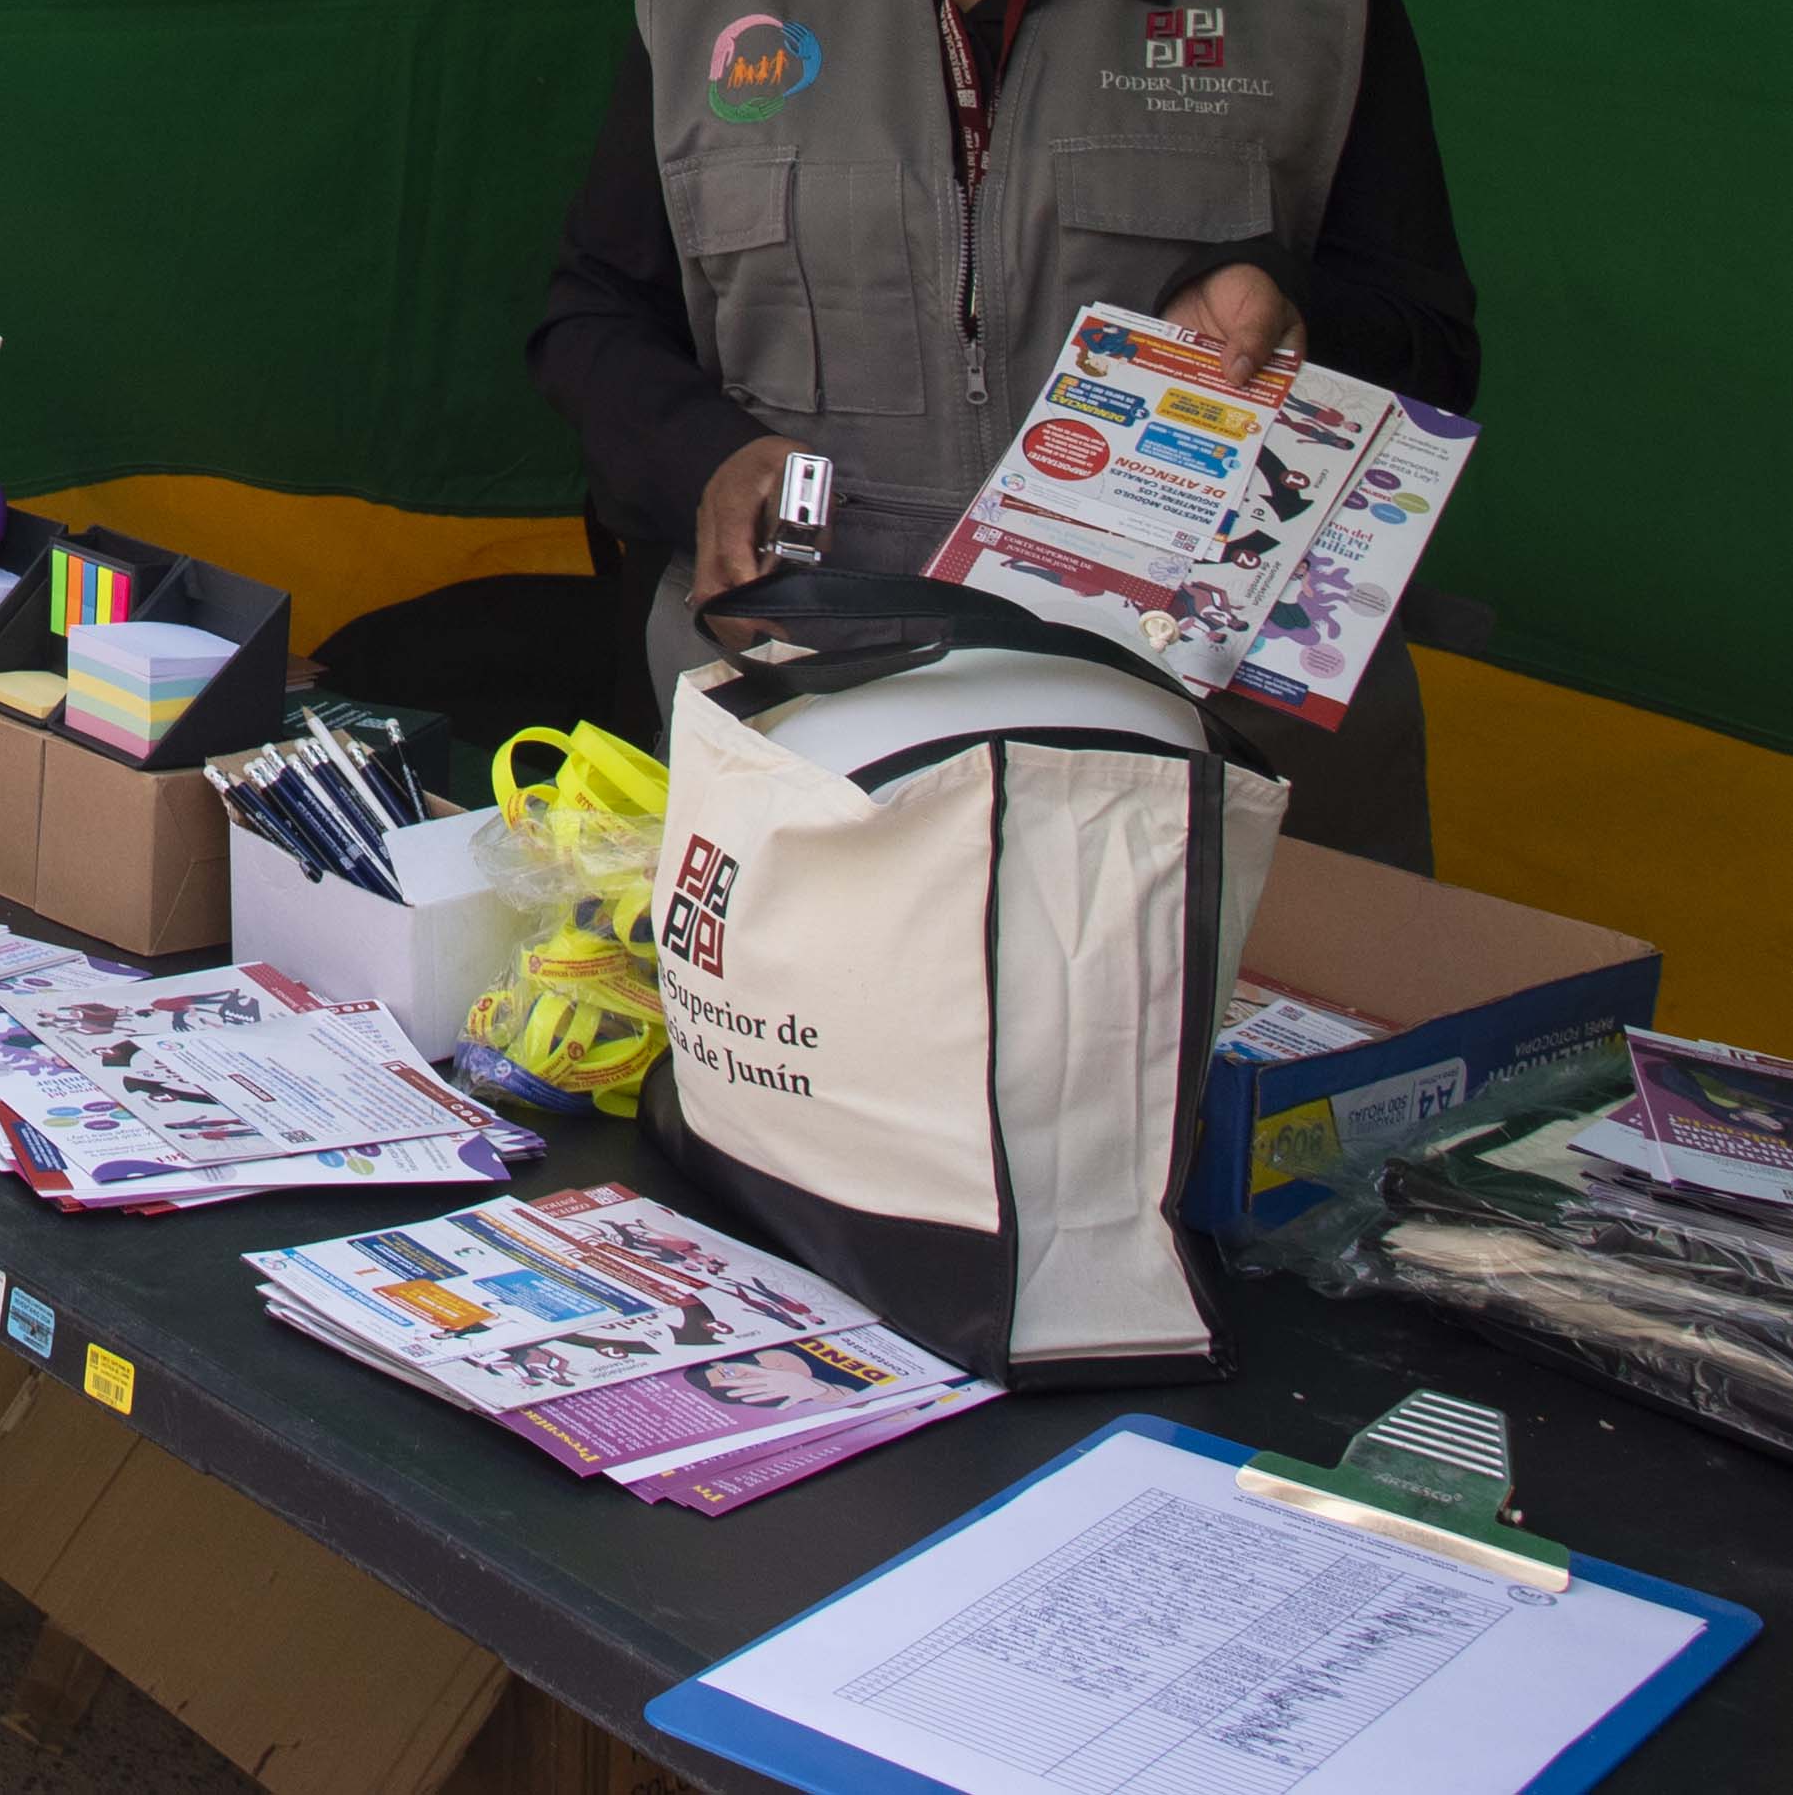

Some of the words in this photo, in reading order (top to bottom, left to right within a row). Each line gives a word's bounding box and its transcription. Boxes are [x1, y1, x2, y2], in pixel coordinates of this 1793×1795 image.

[1050, 394, 1127, 425] DENUNCIAS
[1109, 468, 1159, 493] CANALES
[1113, 456, 1194, 493] ATENCIÓN
[1137, 485, 1155, 499] LOS
[1157, 490, 1217, 517] MANTIENE
[1160, 480, 1220, 510] SIGUIENTES
[1199, 484, 1227, 500] DE
[1163, 501, 1213, 526] NUESTRO
[1350, 526, 1374, 543] del
[666, 969, 768, 1041] Superior
[776, 1014, 819, 1049] de
[1515, 1029, 1580, 1058] FOTOCOPIA
[692, 1034, 720, 1072] de
[722, 1046, 814, 1098] Junín
[1386, 1094, 1409, 1113] 500
[1417, 1078, 1457, 1119] A4
